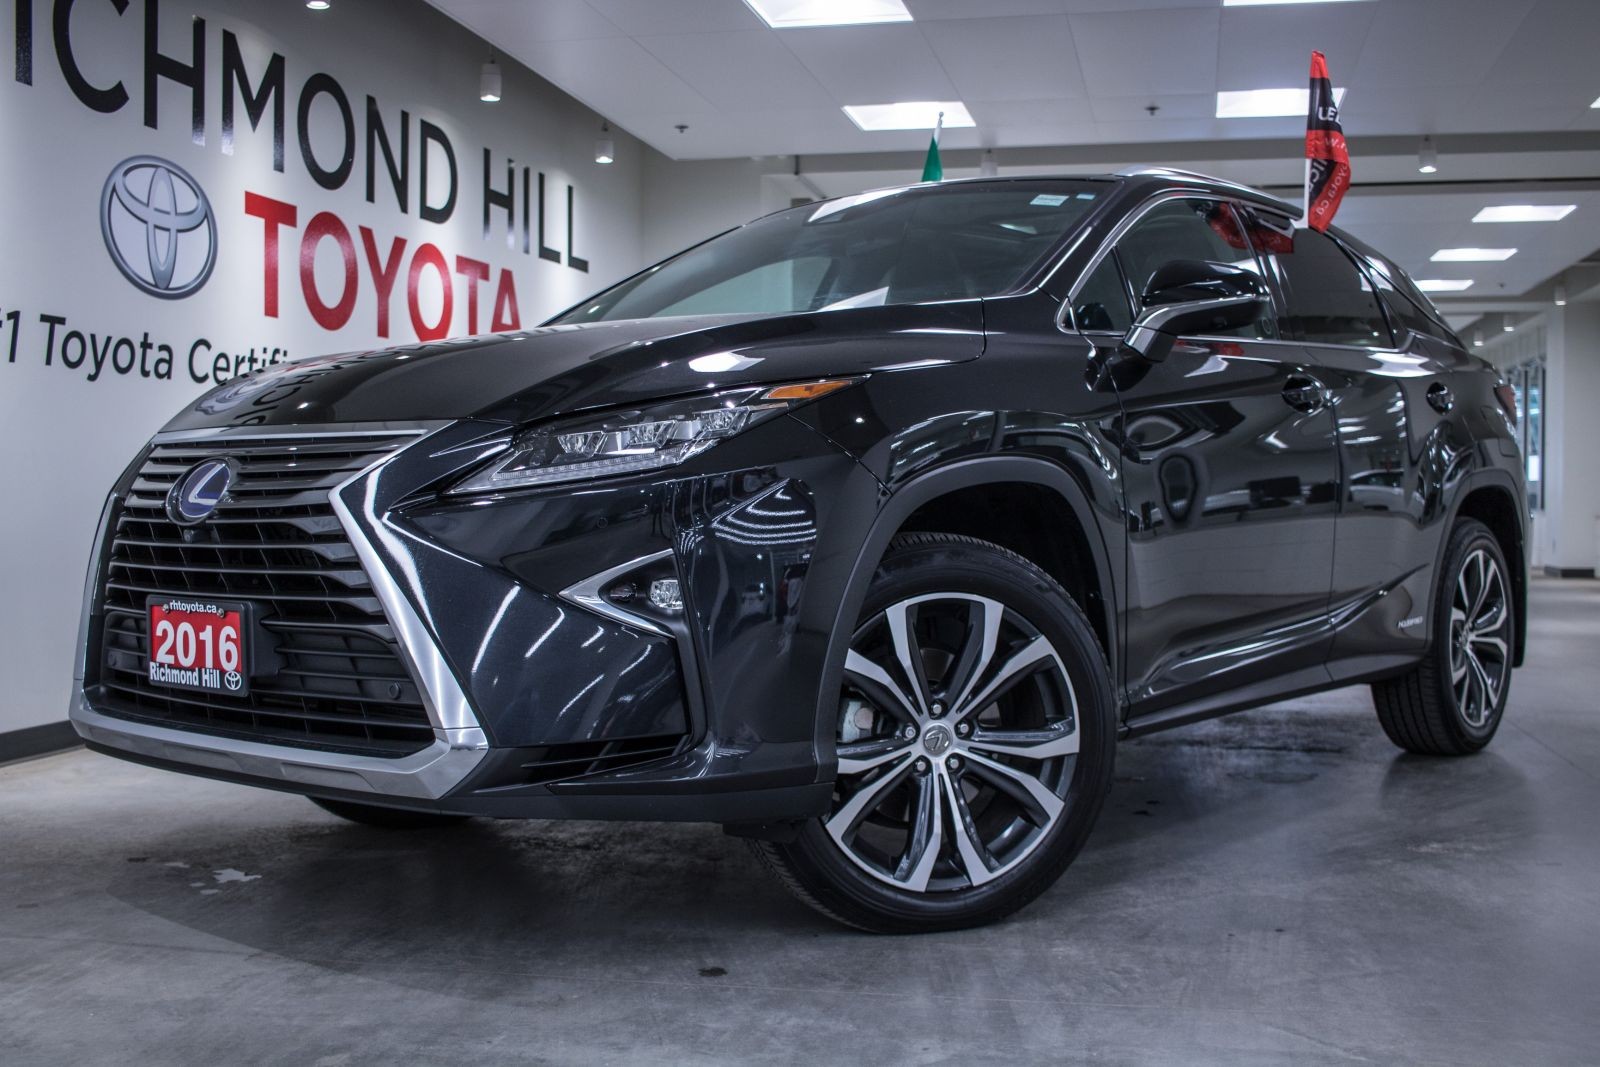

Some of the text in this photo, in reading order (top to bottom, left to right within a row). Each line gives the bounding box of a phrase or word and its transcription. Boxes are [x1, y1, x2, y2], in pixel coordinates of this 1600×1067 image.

[483, 147, 589, 273] HILL
[244, 190, 522, 342] TOYOTA
[0, 308, 21, 363] 1
[39, 313, 174, 383] Toyota
[169, 600, 217, 614] rhtoyota.ca
[149, 661, 221, 689] Richmond Hill
[155, 619, 239, 671] 2016
